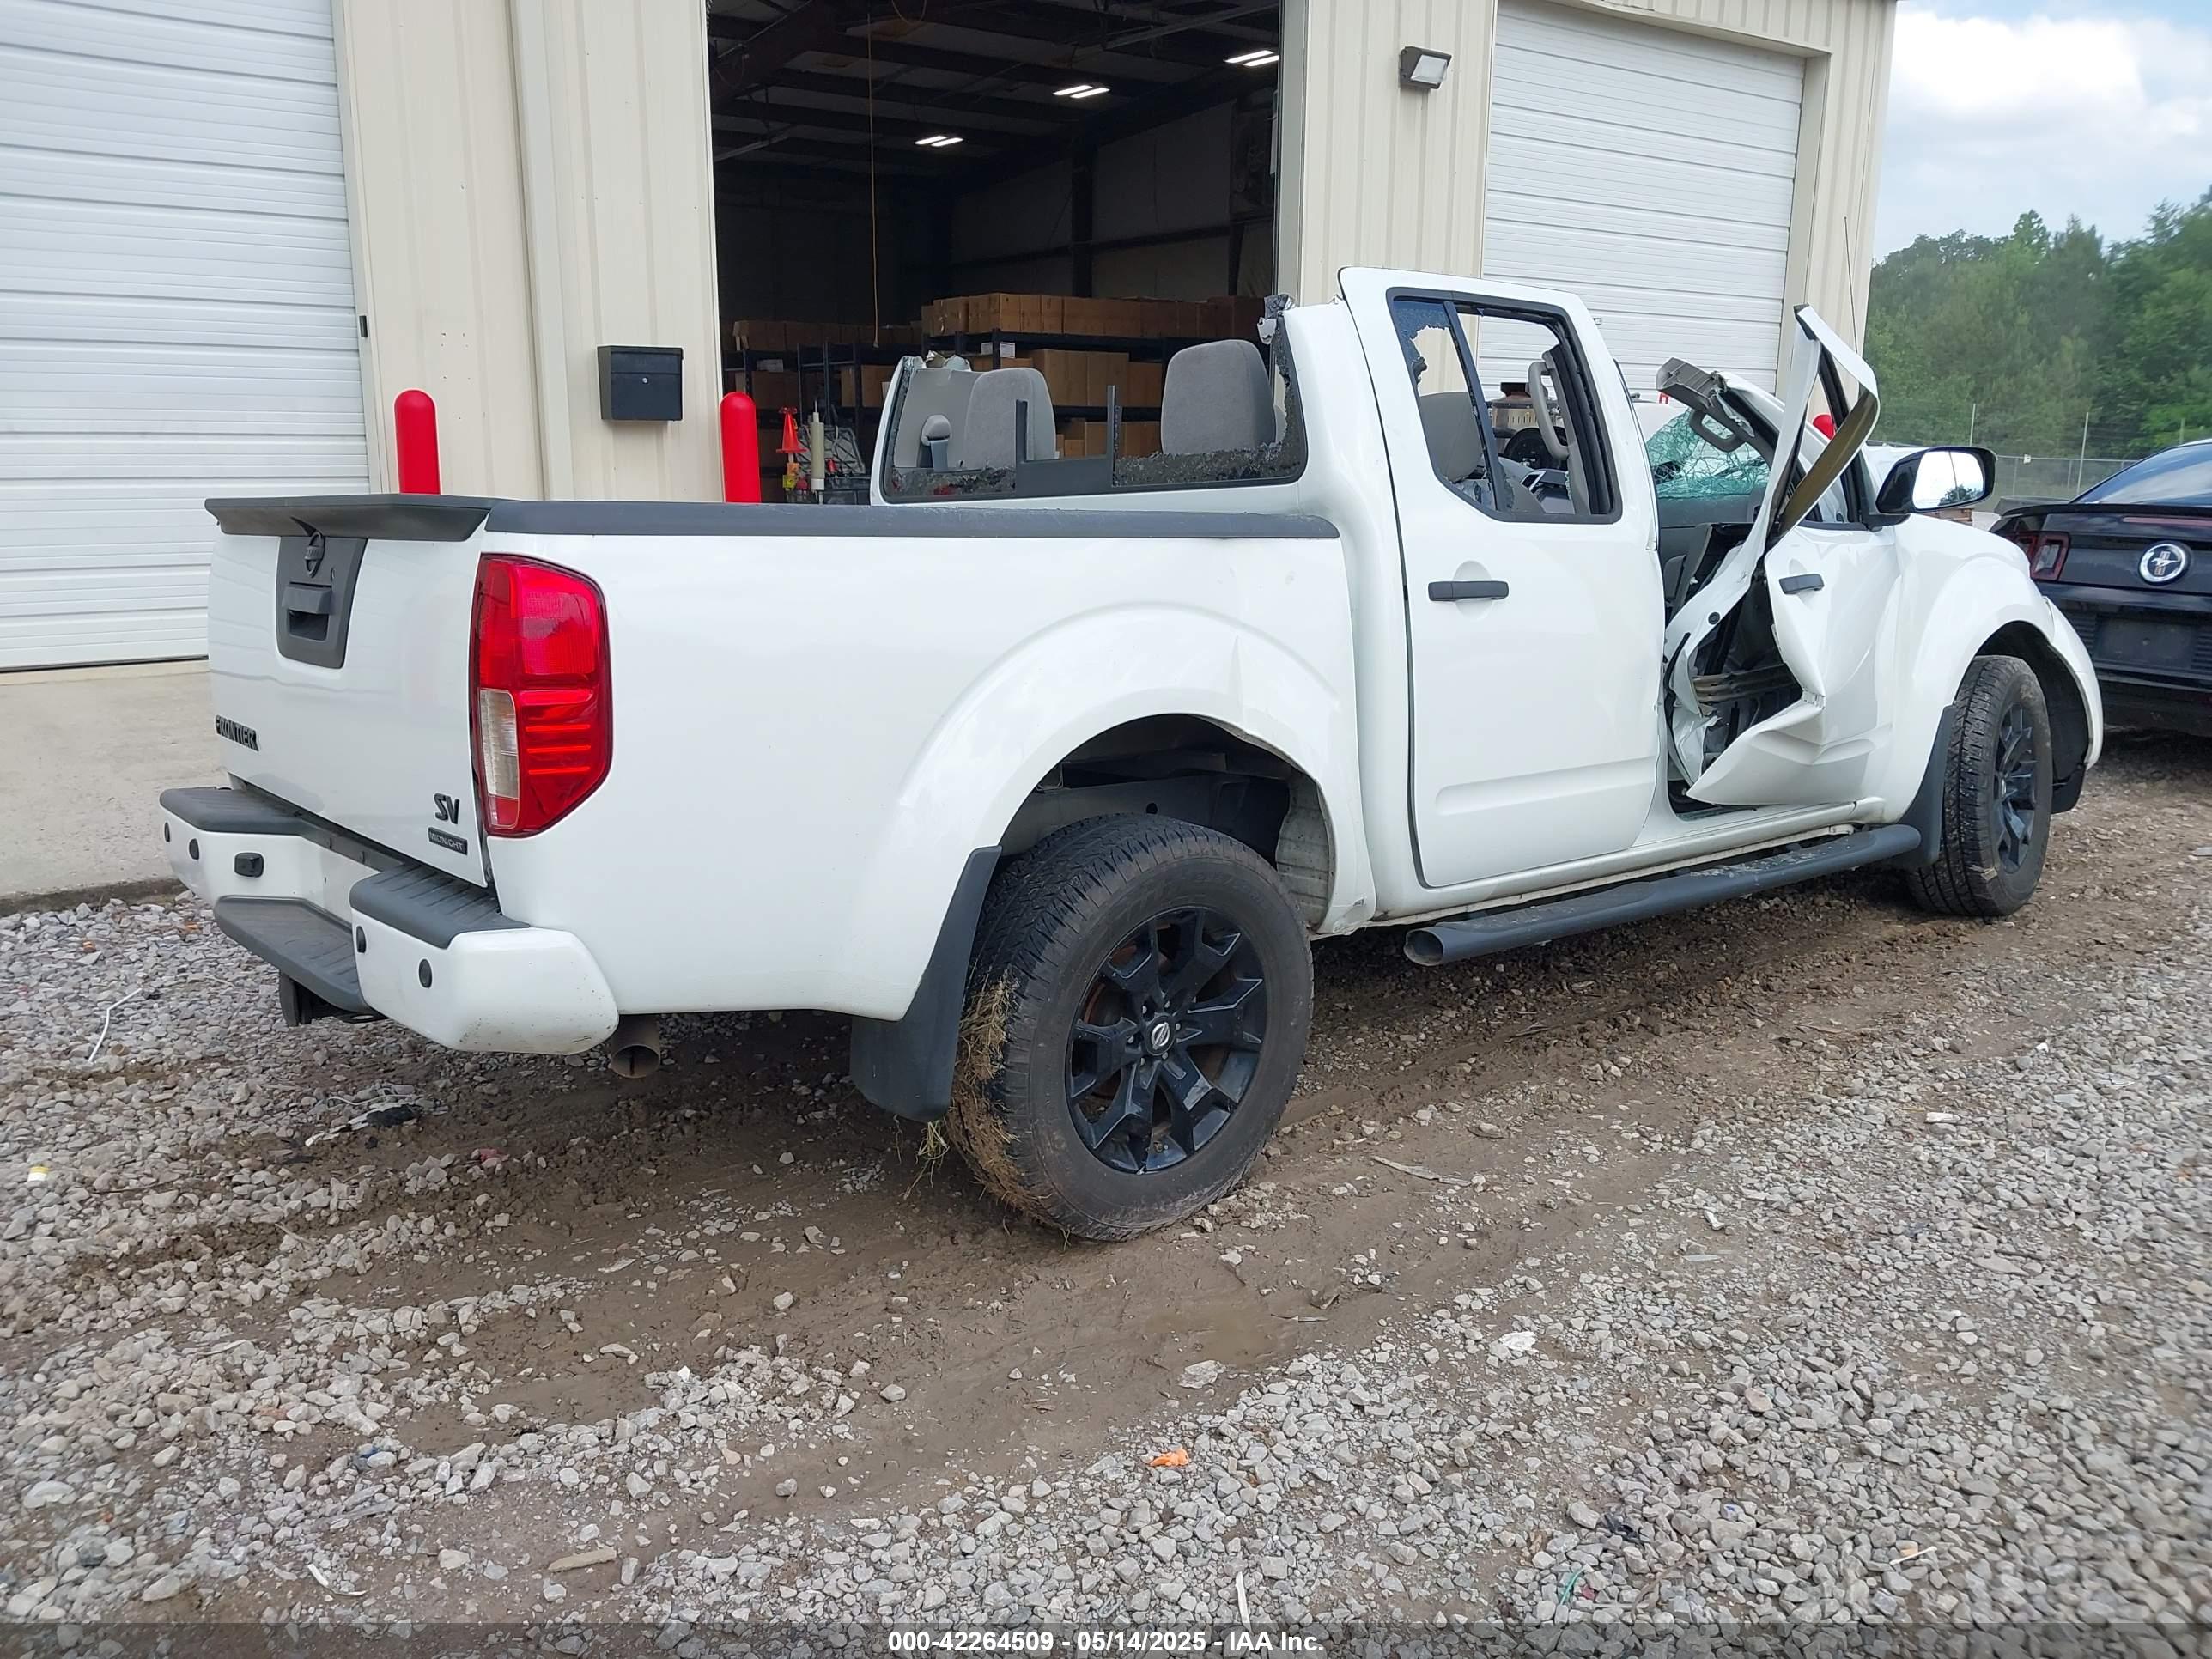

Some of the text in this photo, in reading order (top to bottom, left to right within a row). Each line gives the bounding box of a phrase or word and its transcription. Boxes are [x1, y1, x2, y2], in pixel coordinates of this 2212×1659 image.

[216, 714, 259, 751] FRONTIER
[434, 793, 459, 824] SV
[429, 831, 464, 851] MIDNIGHT
